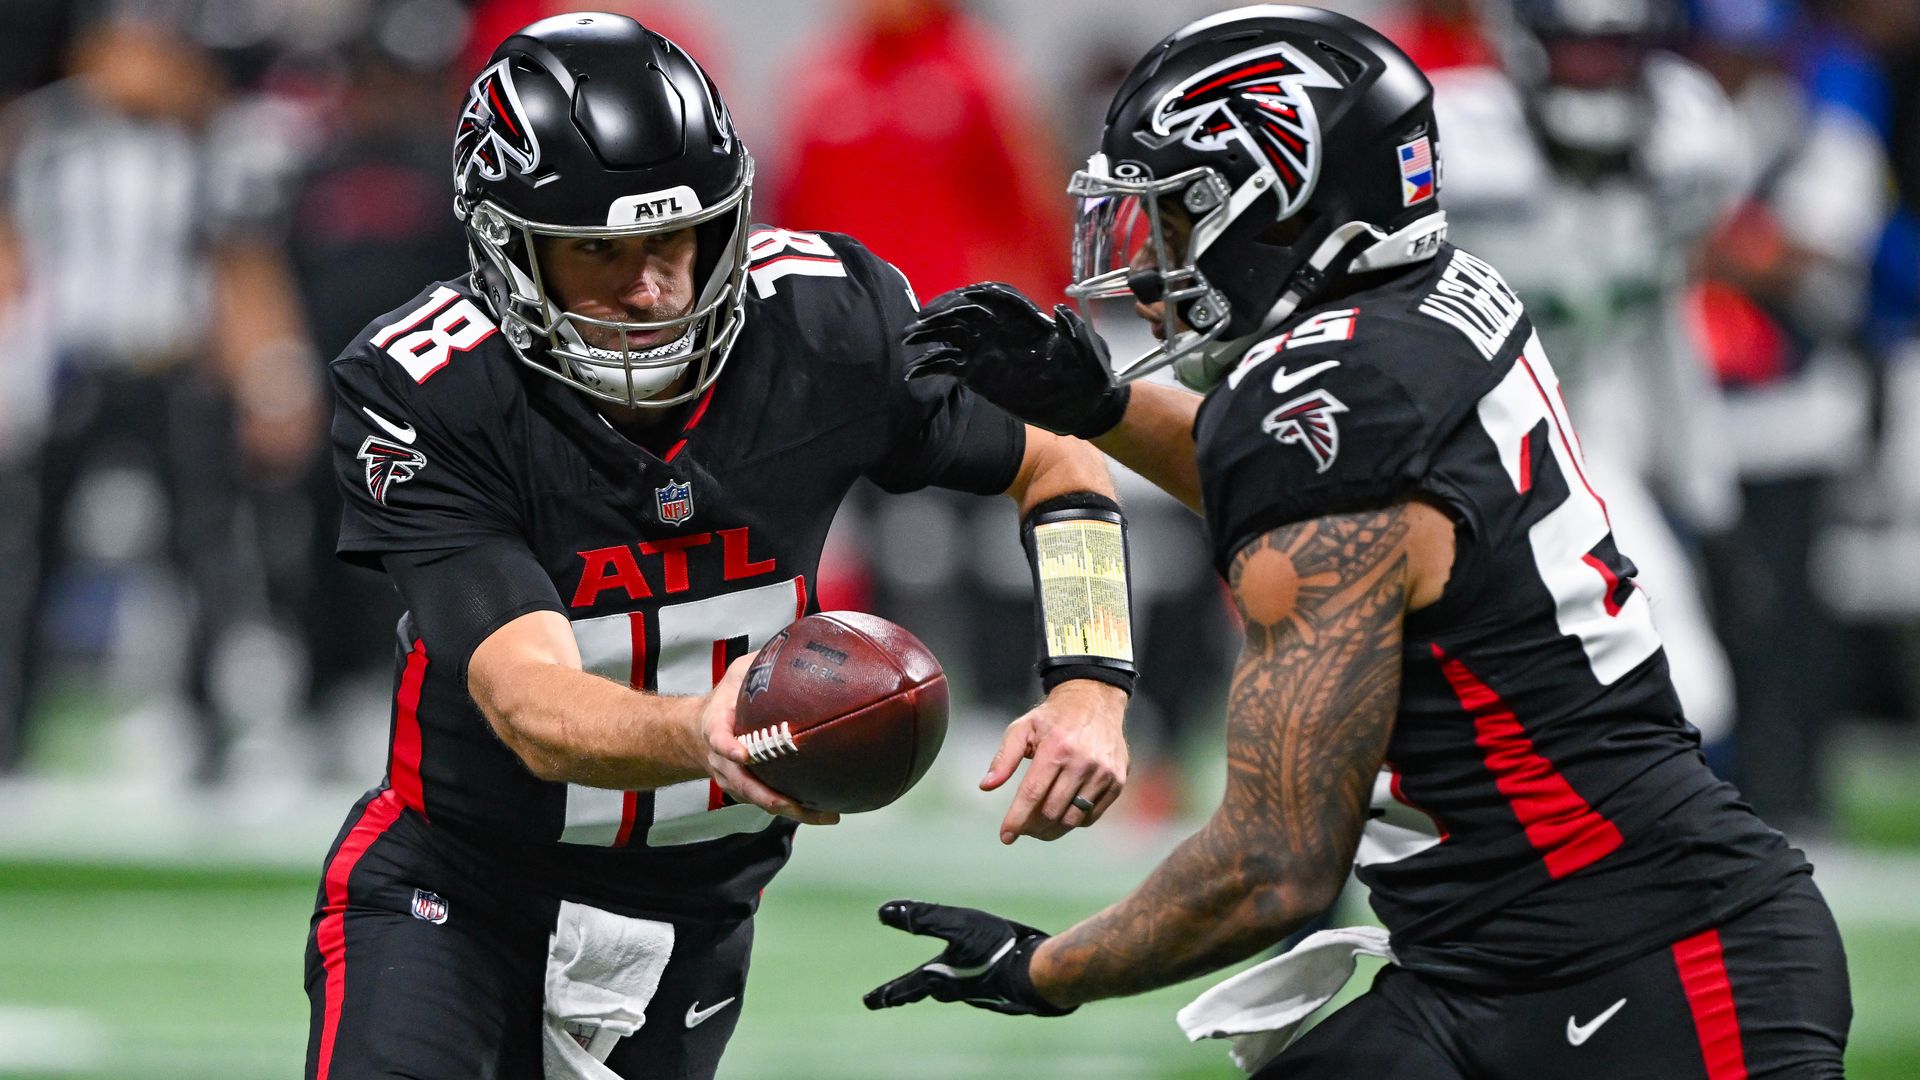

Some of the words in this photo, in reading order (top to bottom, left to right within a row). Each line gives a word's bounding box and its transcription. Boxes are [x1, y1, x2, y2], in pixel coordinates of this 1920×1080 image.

[633, 197, 683, 222] ATL
[369, 285, 499, 385] 18
[662, 500, 690, 520] NFL
[1476, 326, 1664, 686] 2
[571, 526, 776, 608] ATL
[416, 898, 445, 919] NFL
